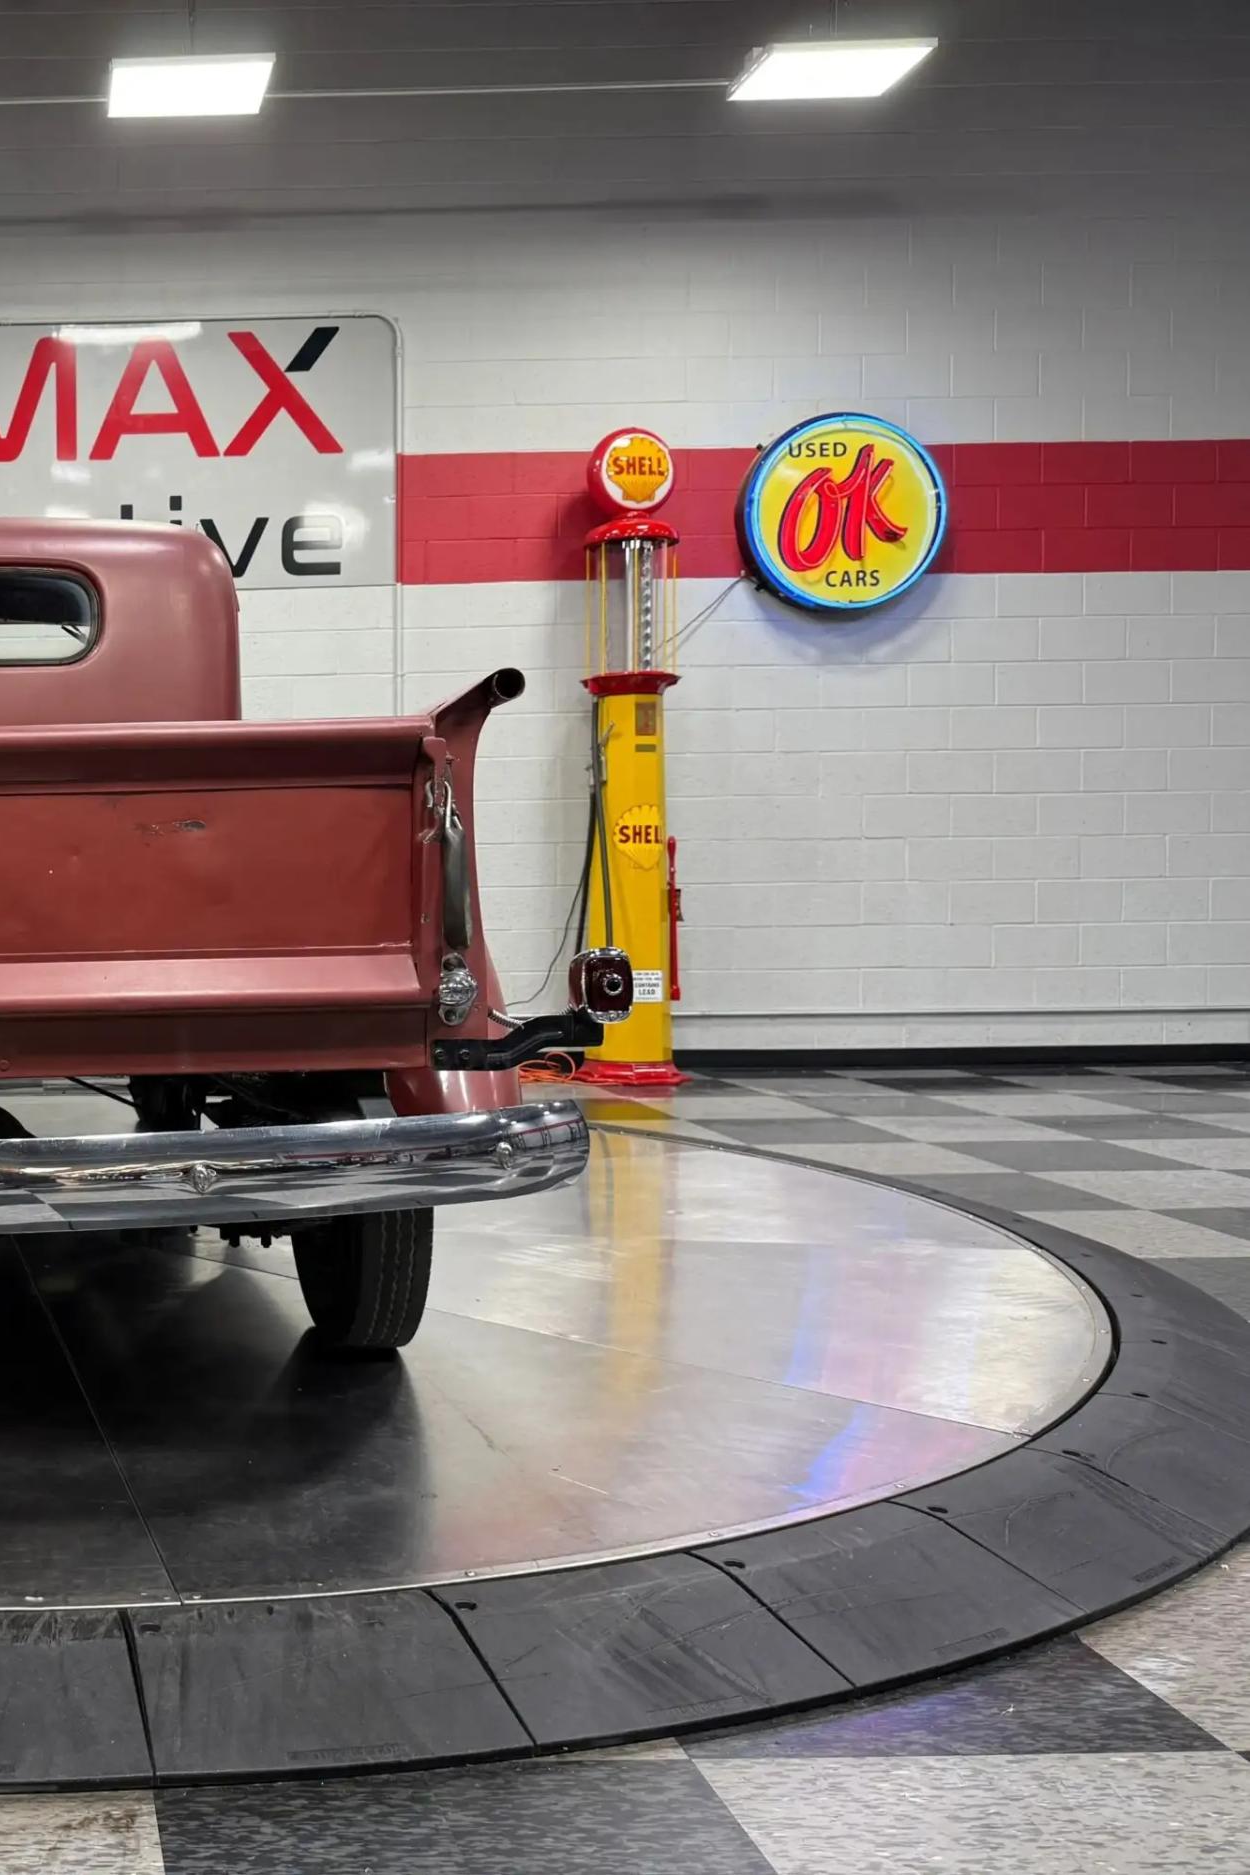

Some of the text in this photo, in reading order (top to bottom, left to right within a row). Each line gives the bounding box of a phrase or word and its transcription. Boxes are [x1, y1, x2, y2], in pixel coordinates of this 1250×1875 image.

[788, 442, 848, 458] USED
[612, 455, 665, 476] SHELL
[777, 443, 908, 572] OK
[825, 569, 880, 587] CARS
[618, 825, 663, 844] SHEL
